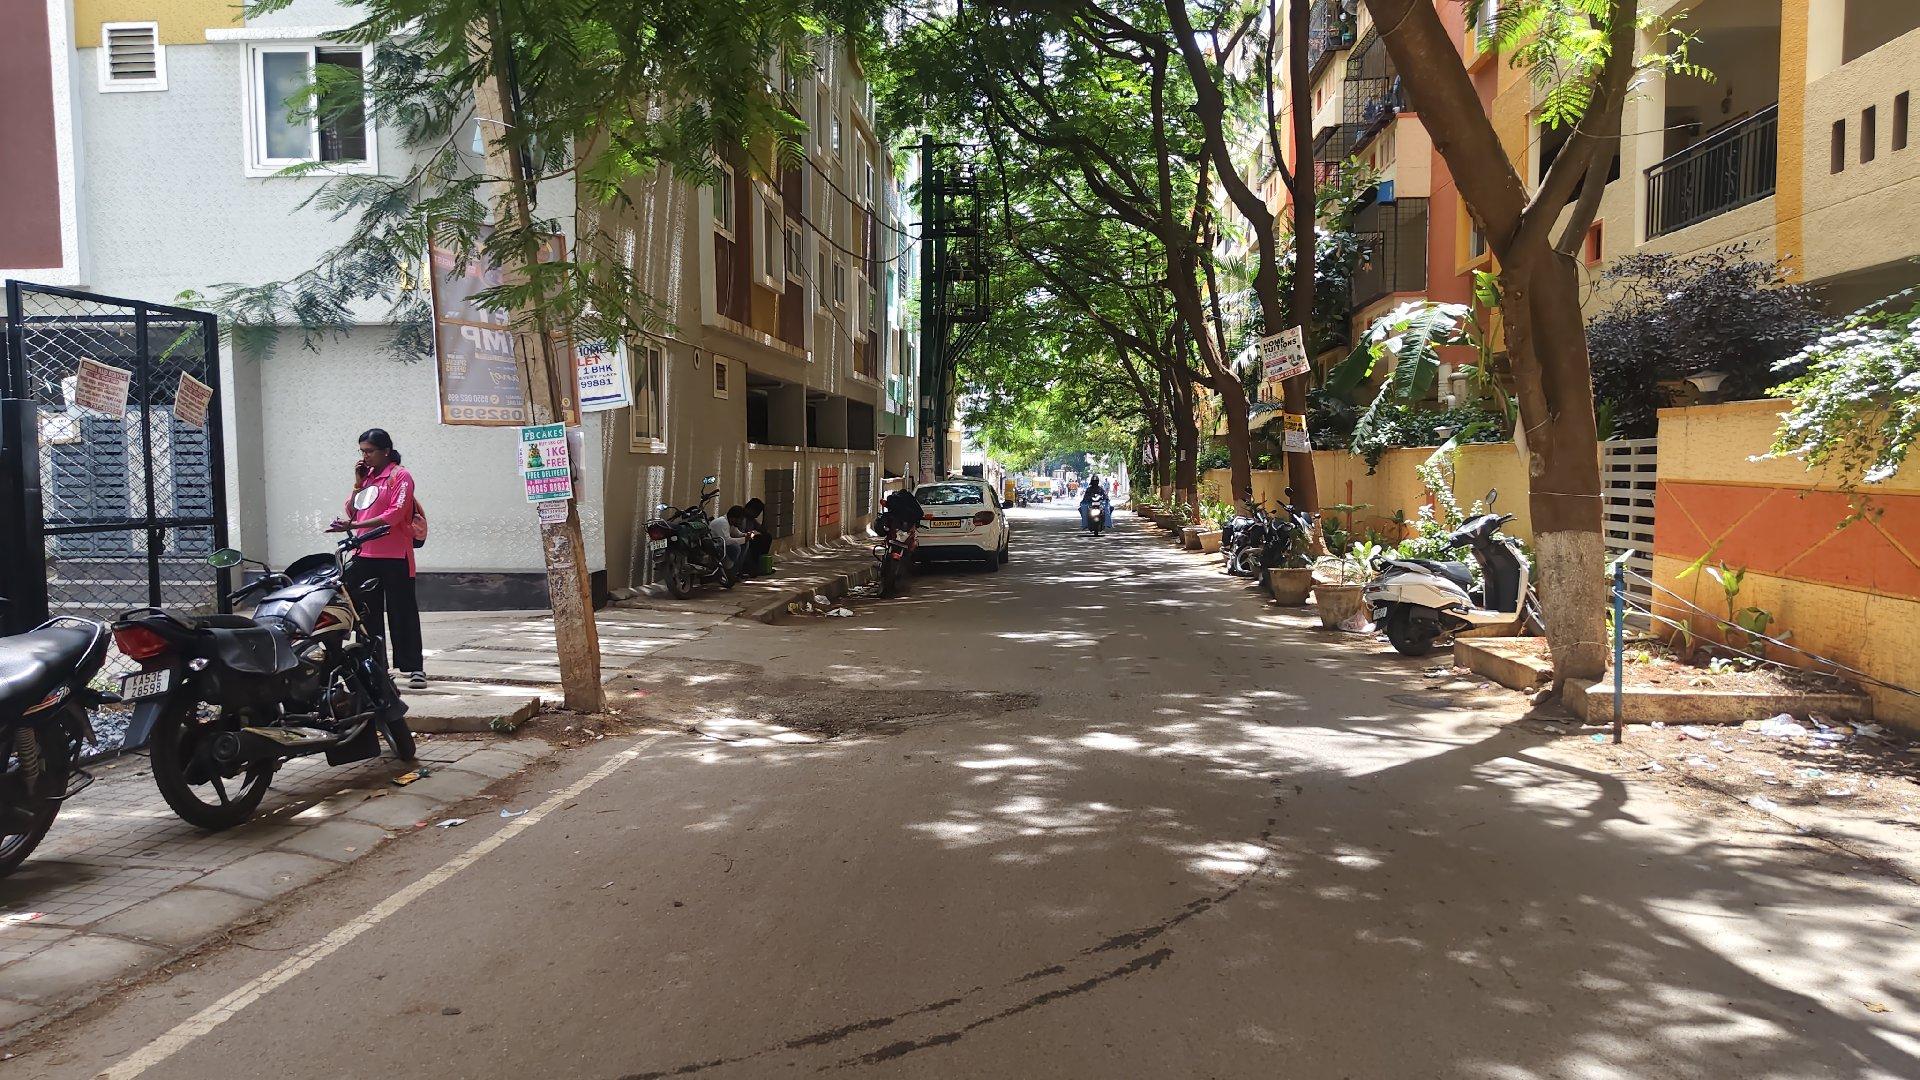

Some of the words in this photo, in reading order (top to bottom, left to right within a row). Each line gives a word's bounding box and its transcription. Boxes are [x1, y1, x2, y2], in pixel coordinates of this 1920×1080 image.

[1263, 337, 1285, 349] HOME
[1264, 339, 1297, 354] TUITIONS
[578, 355, 599, 366] LET
[591, 364, 613, 373] BHK
[546, 457, 567, 467] FREE
[527, 471, 540, 479] FREE
[133, 672, 162, 686] KA53E
